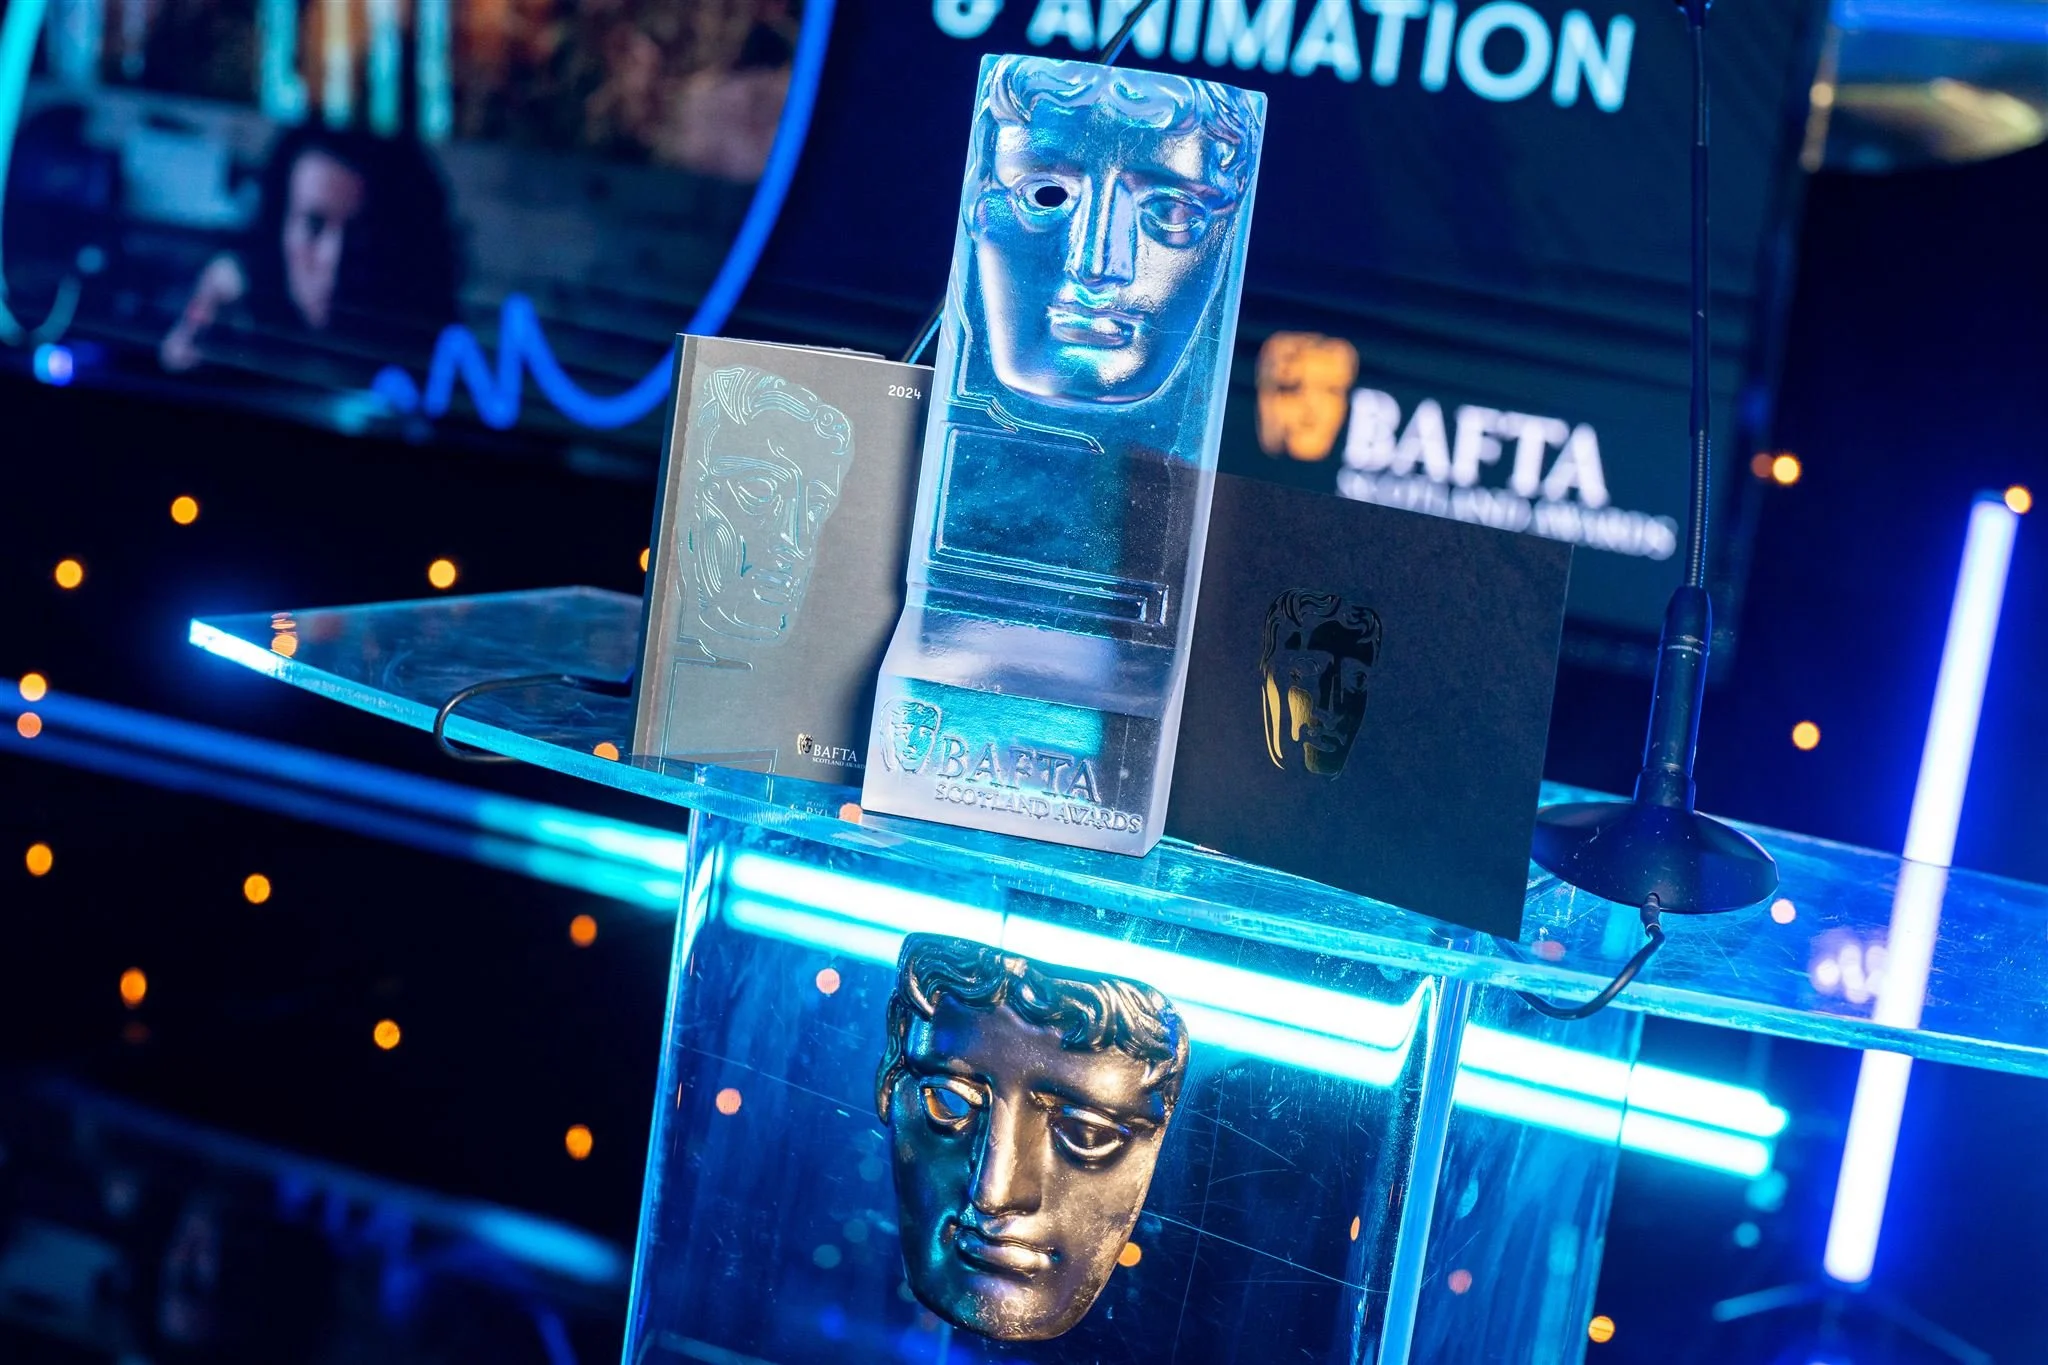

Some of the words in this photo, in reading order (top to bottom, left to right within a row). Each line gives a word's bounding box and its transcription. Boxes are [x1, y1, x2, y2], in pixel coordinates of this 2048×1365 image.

[1026, 0, 1635, 112] ANIMATION
[888, 384, 921, 400] 2024
[1343, 387, 1608, 507] BAFTA
[812, 757, 845, 767] SCOTLAND
[813, 744, 857, 762] BAFTA
[937, 735, 1101, 803] BAFTA
[934, 783, 1050, 820] SCOTLAND
[1054, 801, 1144, 834] AWARDS
